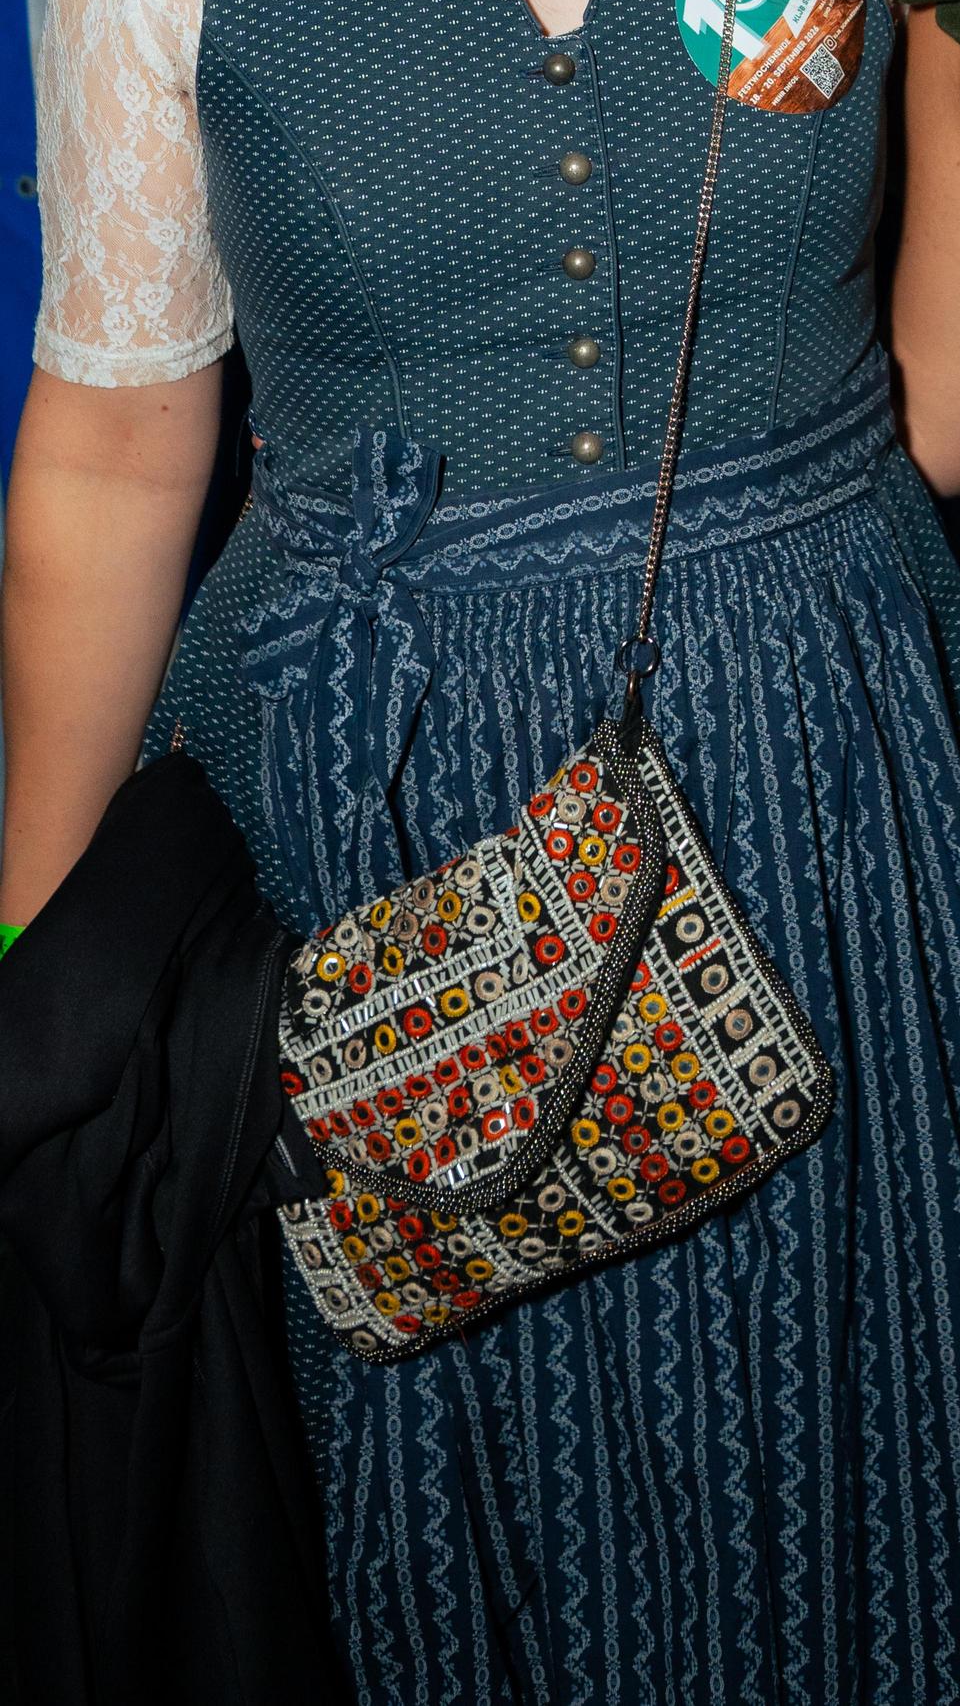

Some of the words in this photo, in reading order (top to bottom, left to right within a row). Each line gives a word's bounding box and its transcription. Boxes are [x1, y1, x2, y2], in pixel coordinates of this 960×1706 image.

[792, 5, 806, 24] KLJB
[738, 38, 791, 98] FESTWOCHENENDE
[749, 93, 763, 105] 18.
[763, 77, 777, 89] 20.
[773, 40, 808, 77] SEPTEMBER
[803, 25, 820, 42] 2026
[771, 90, 786, 106] MEHR
